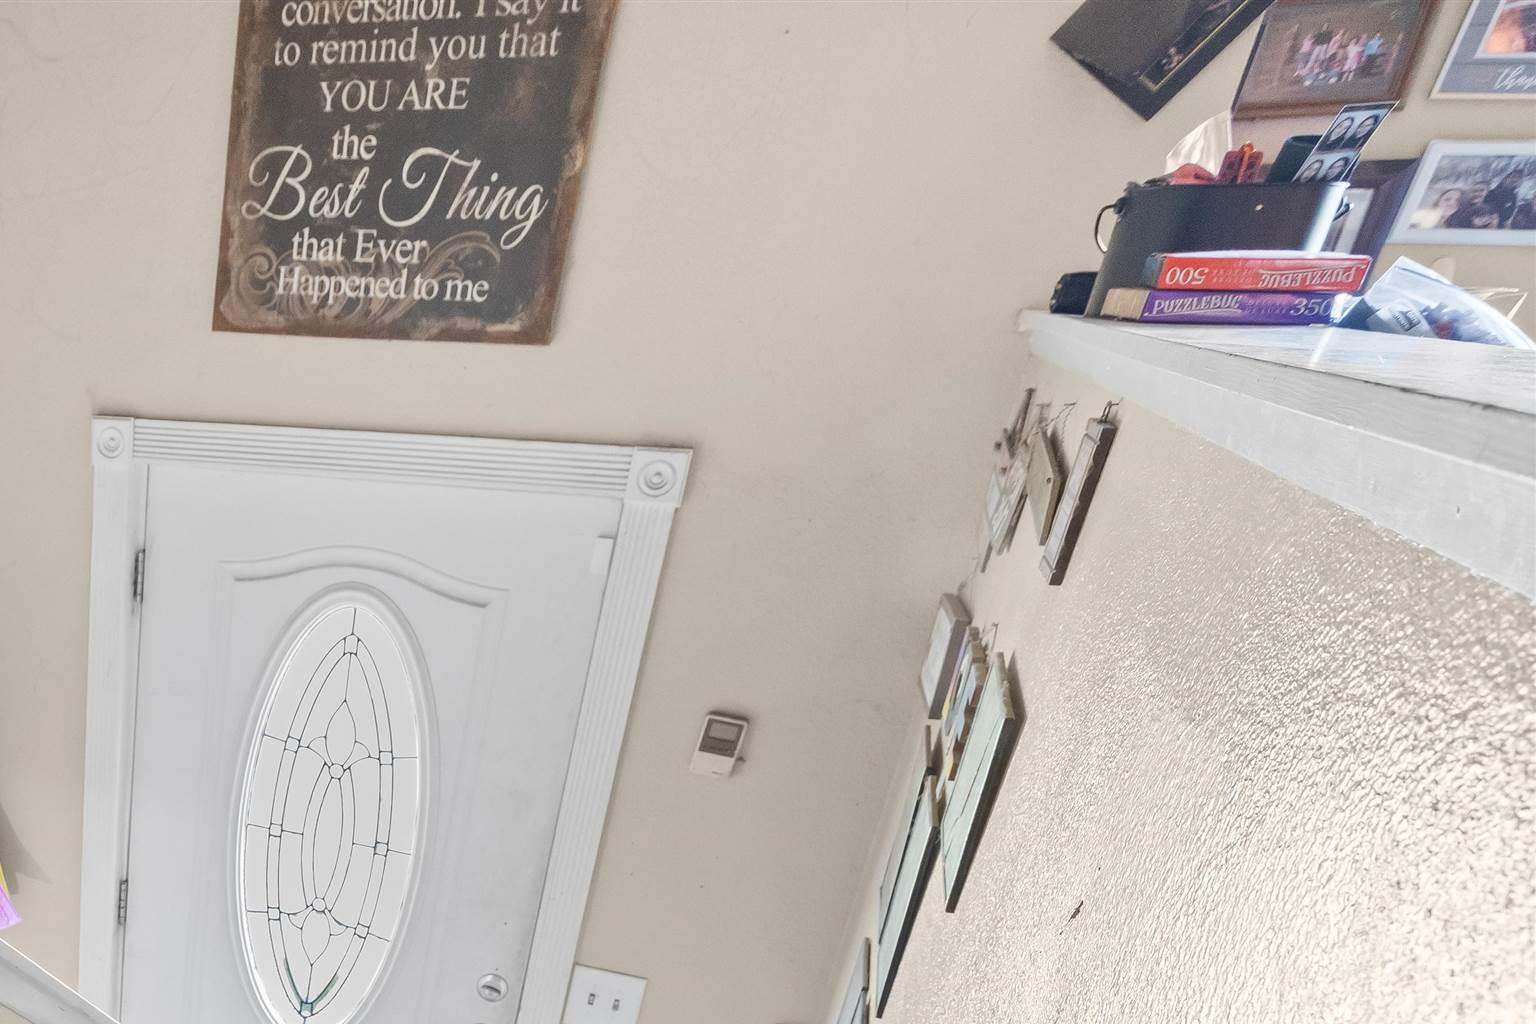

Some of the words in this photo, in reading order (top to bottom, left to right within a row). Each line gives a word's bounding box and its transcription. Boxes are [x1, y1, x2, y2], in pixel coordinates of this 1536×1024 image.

[274, 37, 301, 66] to
[309, 27, 418, 65] remind
[424, 34, 487, 71] you
[498, 24, 562, 59] that
[320, 80, 392, 113] YOU
[397, 77, 470, 111] ARE
[331, 125, 378, 161] the
[240, 143, 370, 221] Best
[378, 146, 550, 251] Thing
[291, 230, 346, 263] that
[354, 229, 428, 264] Ever
[275, 265, 408, 305] Happened
[412, 274, 439, 300] to
[445, 277, 490, 302] me
[1166, 267, 1209, 285] 500
